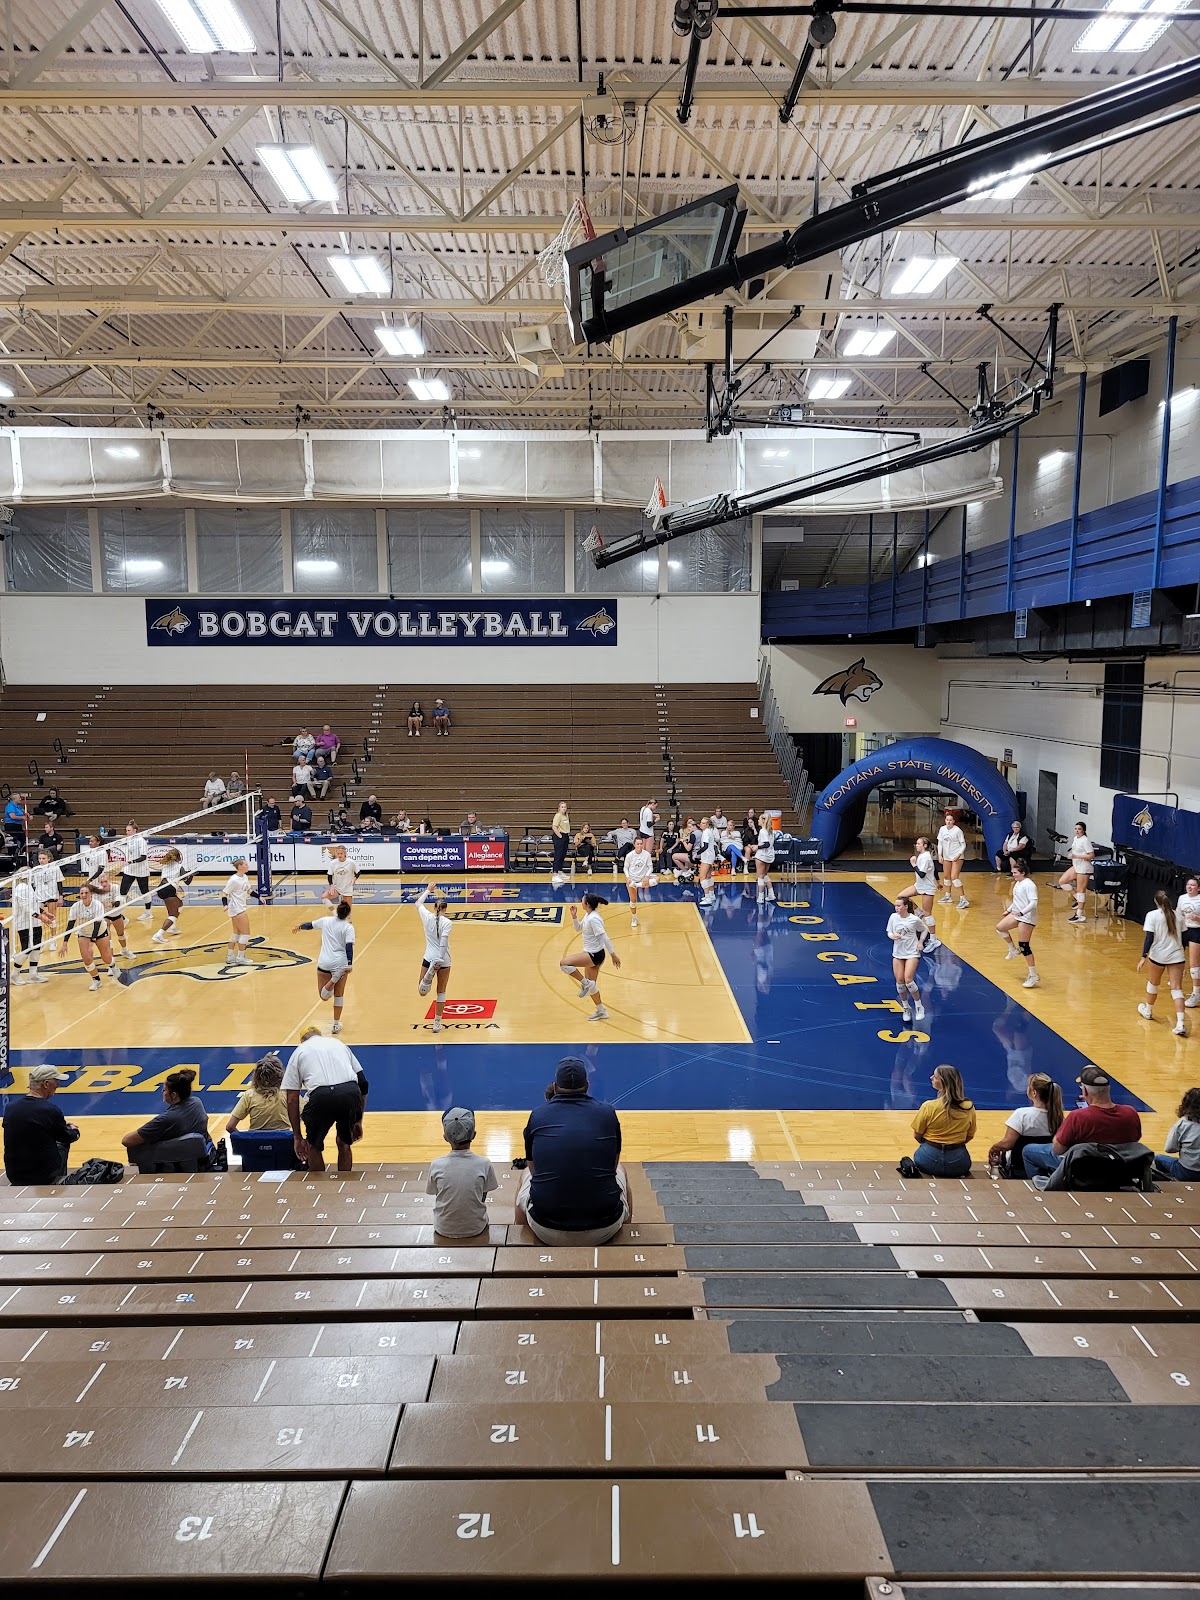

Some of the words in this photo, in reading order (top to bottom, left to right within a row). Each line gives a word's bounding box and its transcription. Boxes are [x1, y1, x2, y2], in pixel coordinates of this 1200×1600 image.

[199, 611, 338, 637] BOBCAT
[348, 611, 568, 638] VOLLEYBALL
[824, 766, 884, 810] MONTANA
[888, 760, 932, 771] STATE
[936, 765, 998, 817] UNIVERSITY
[406, 847, 443, 855] Coverage
[443, 847, 458, 855] you
[468, 852, 503, 860] Allegiance
[249, 852, 285, 862] Hlth
[418, 854, 448, 862] depend
[776, 901, 931, 1043] BOBCATS
[410, 1022, 501, 1031] TOYOTA
[294, 1291, 310, 1299] 14
[413, 1290, 428, 1298] 13
[529, 1288, 545, 1296] 12
[992, 1289, 1004, 1297] 8
[1109, 1290, 1119, 1298] 7
[58, 1296, 76, 1304] 16
[176, 1294, 195, 1302] 15
[234, 1339, 254, 1349] 14
[378, 1337, 397, 1347] 13
[518, 1334, 537, 1345] 12
[655, 1334, 670, 1344] 11
[1073, 1337, 1089, 1347] 8
[89, 1341, 110, 1351] 15
[337, 1373, 359, 1387] 13
[505, 1371, 528, 1384] 12
[674, 1371, 692, 1384] 11
[1171, 1373, 1190, 1386] 8
[164, 1377, 188, 1389] 14
[277, 1428, 303, 1445] 13
[491, 1425, 519, 1442] 12
[697, 1425, 720, 1442] 11
[62, 1431, 95, 1447] 14
[176, 1517, 214, 1541] 13
[457, 1514, 494, 1538] 12
[733, 1513, 765, 1537] 11
